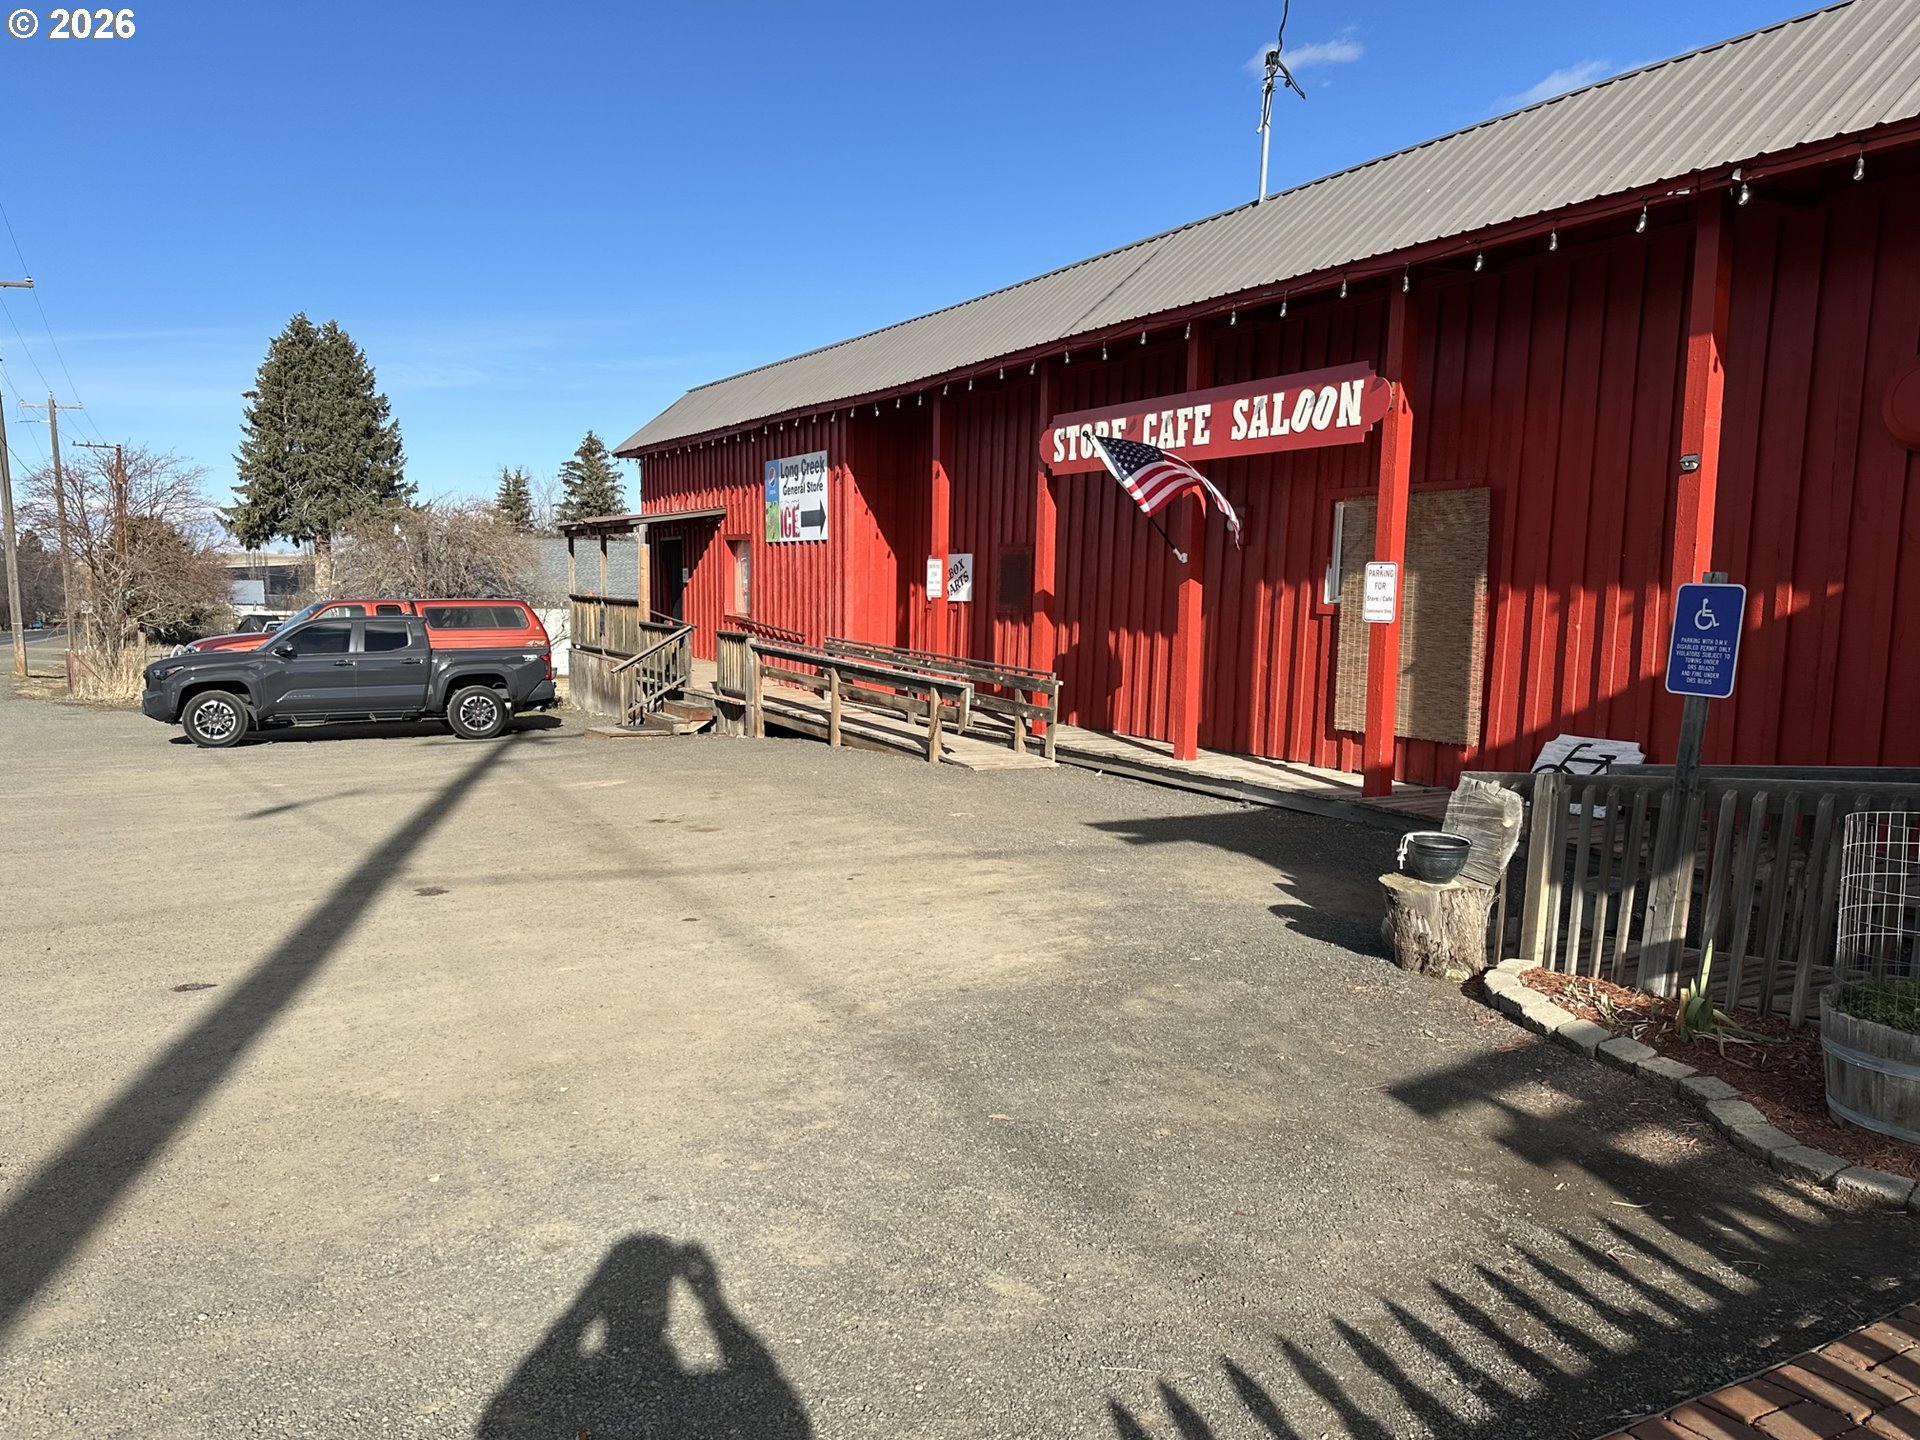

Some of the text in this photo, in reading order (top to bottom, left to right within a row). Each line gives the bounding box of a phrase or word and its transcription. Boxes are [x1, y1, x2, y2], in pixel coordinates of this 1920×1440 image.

[1143, 404, 1212, 450] CAFE
[1230, 379, 1365, 441] SALOON
[780, 456, 825, 481] Long Creek
[783, 484, 805, 496] General
[807, 482, 823, 493] Store
[780, 502, 800, 538] ICE
[1368, 569, 1394, 578] PARKING
[1375, 582, 1387, 590] FOR
